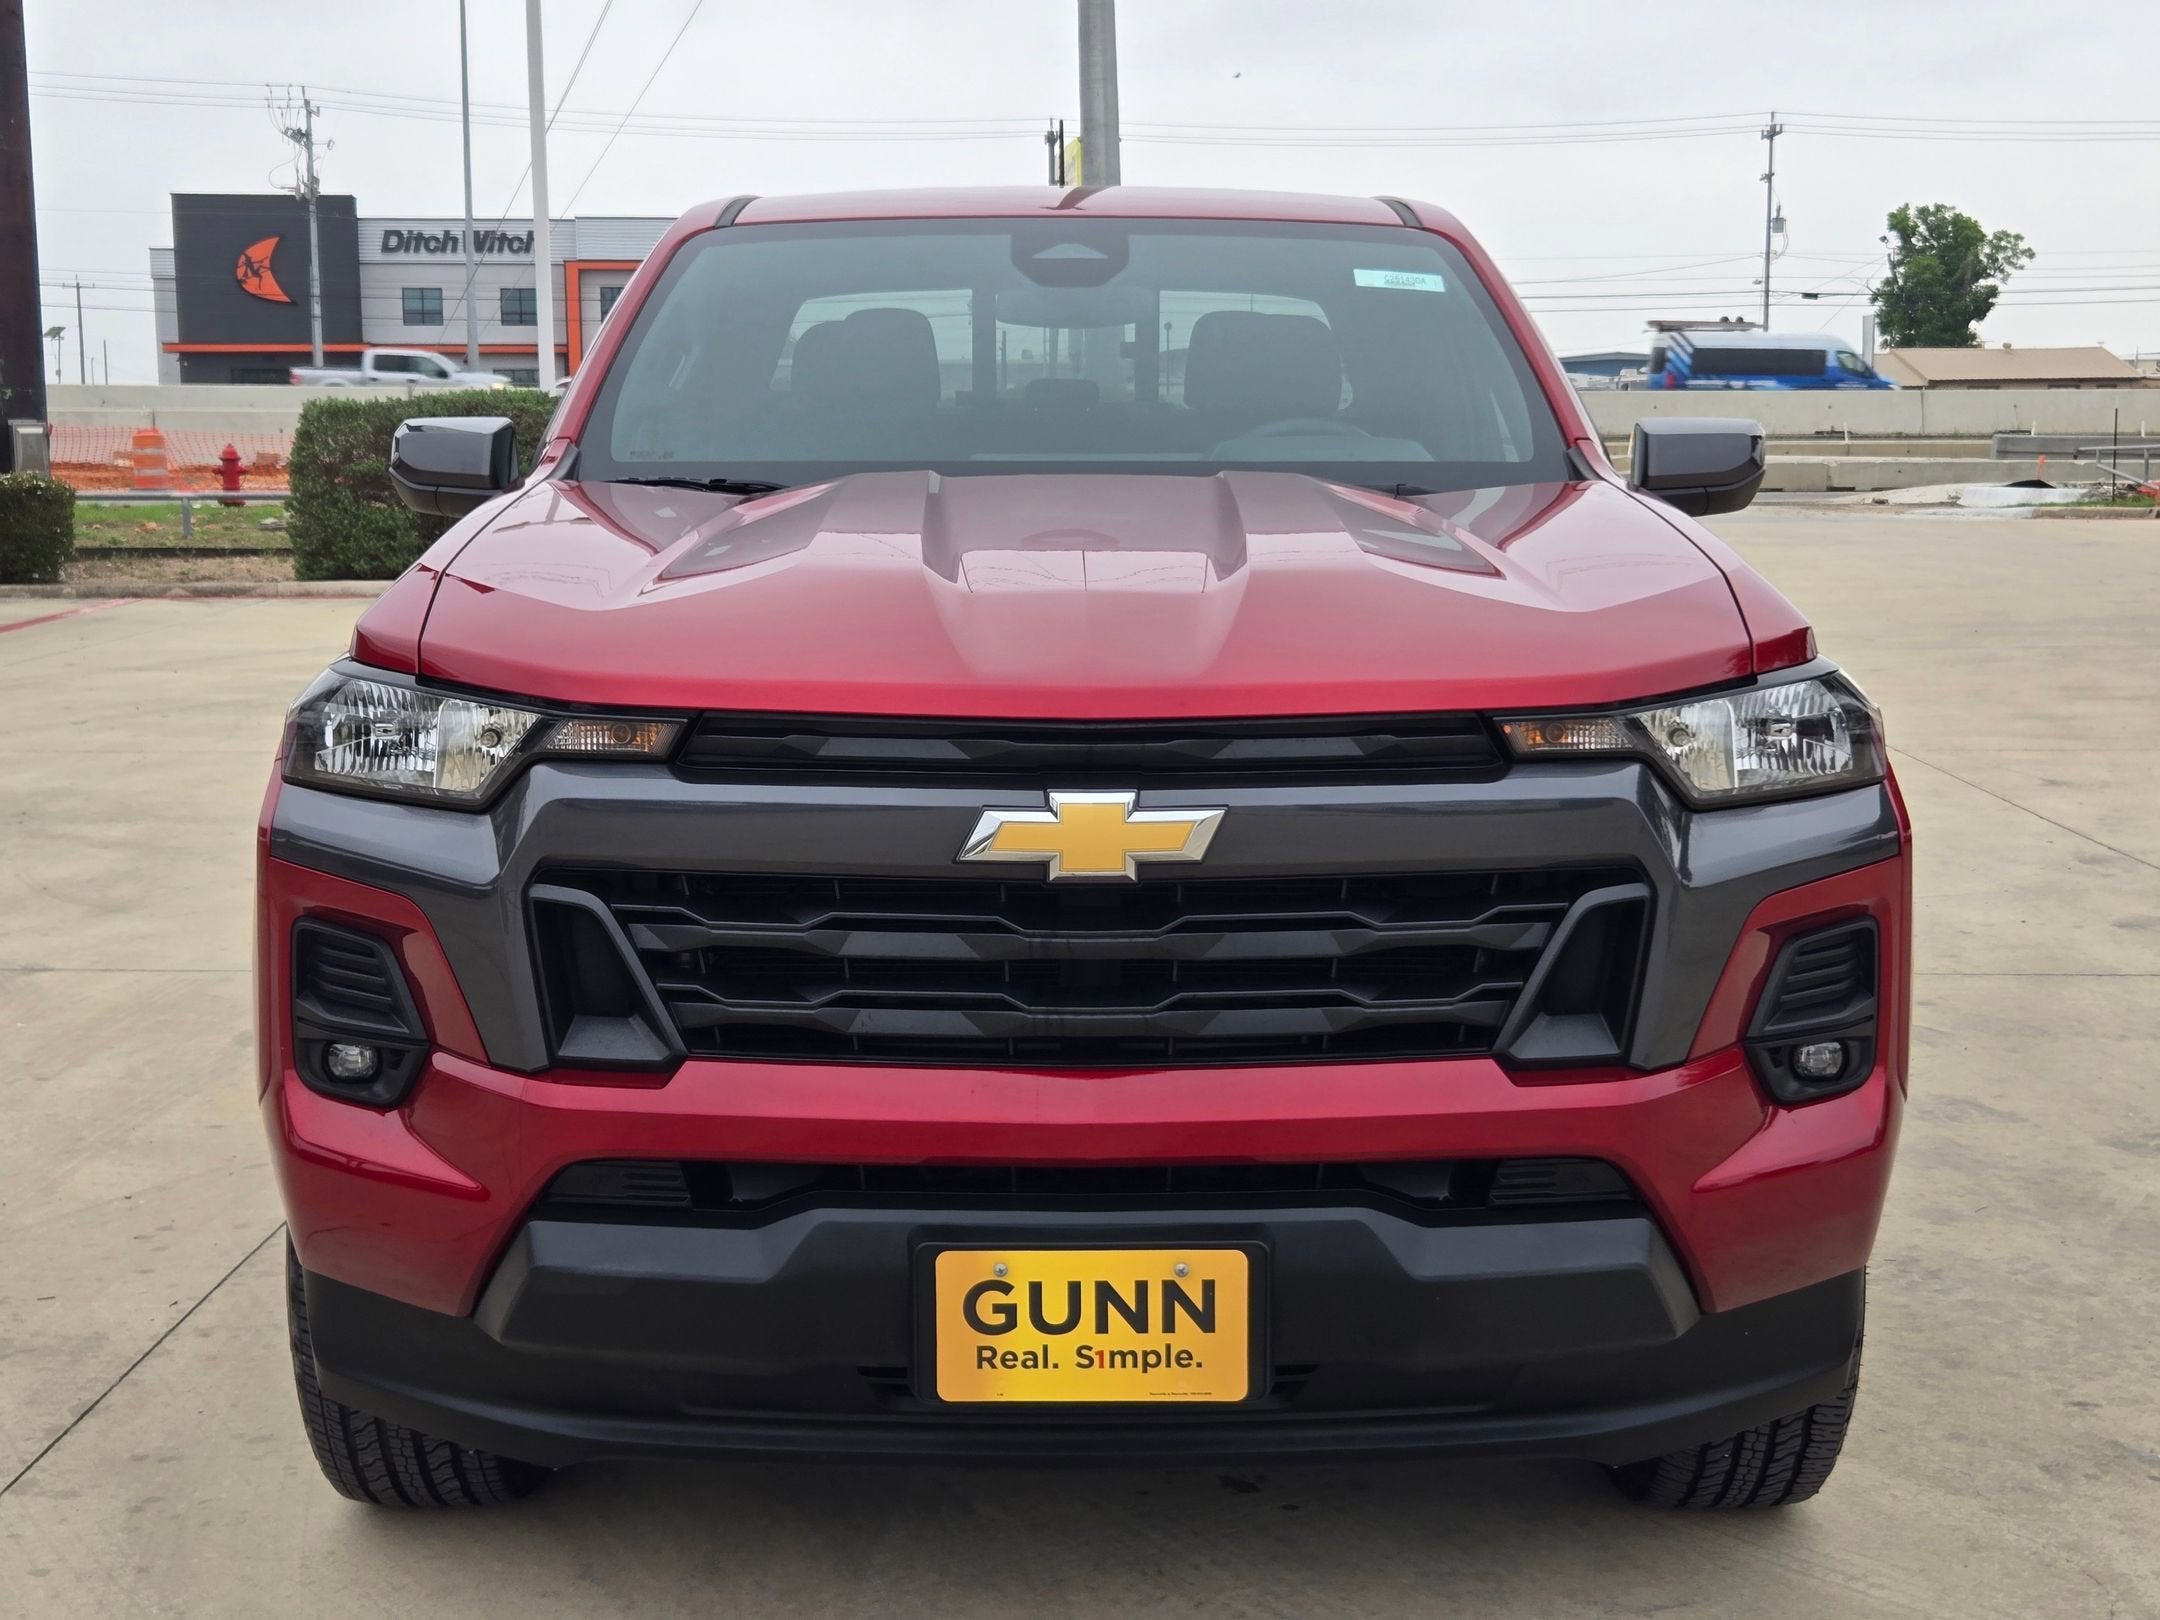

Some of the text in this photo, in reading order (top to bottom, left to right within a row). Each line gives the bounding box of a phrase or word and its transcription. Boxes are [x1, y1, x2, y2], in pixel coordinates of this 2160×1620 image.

[381, 230, 458, 254] Ditch
[962, 1279, 1216, 1335] GUNN
[976, 1343, 1202, 1373] Real. S1mple.
